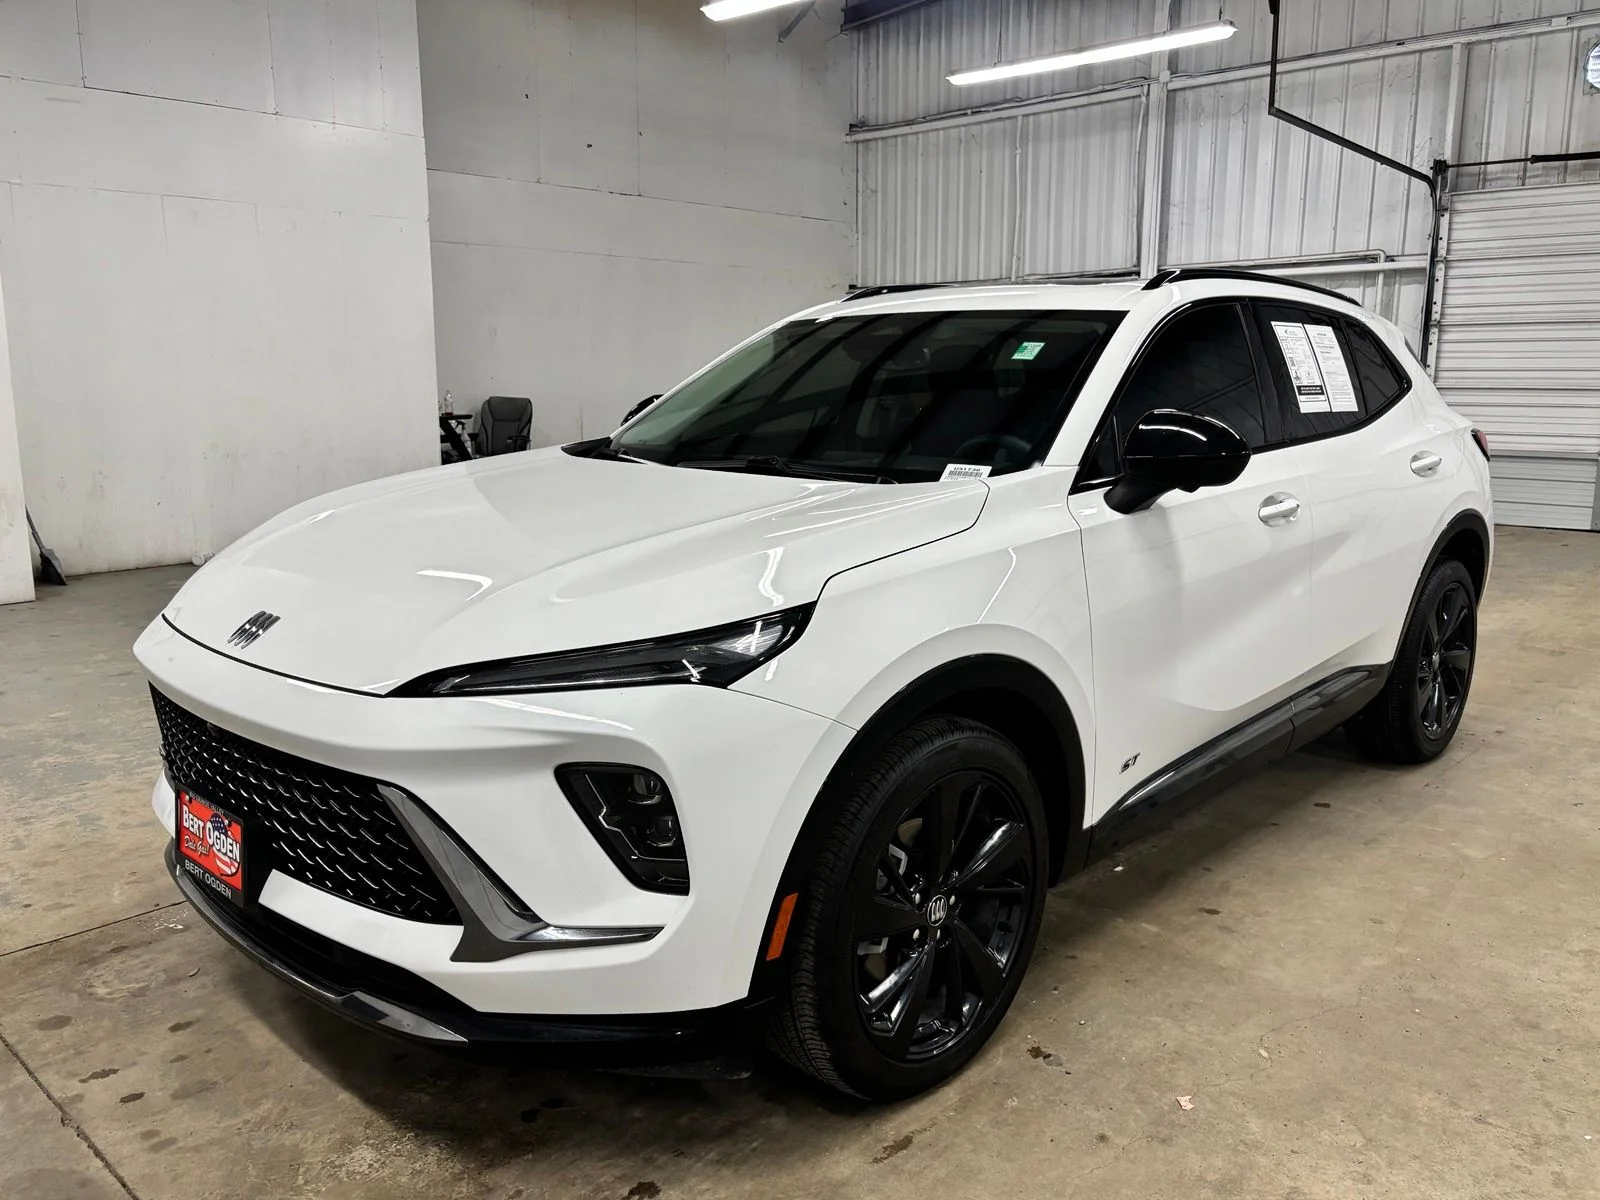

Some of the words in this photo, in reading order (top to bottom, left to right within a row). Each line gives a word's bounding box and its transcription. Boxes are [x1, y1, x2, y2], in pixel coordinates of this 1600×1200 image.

[1119, 752, 1141, 775] ST
[210, 803, 225, 816] VALLEY
[182, 804, 205, 839] BERT
[205, 821, 240, 863] OGDEN
[184, 859, 204, 880] BERT
[204, 873, 232, 899] OGDEN
